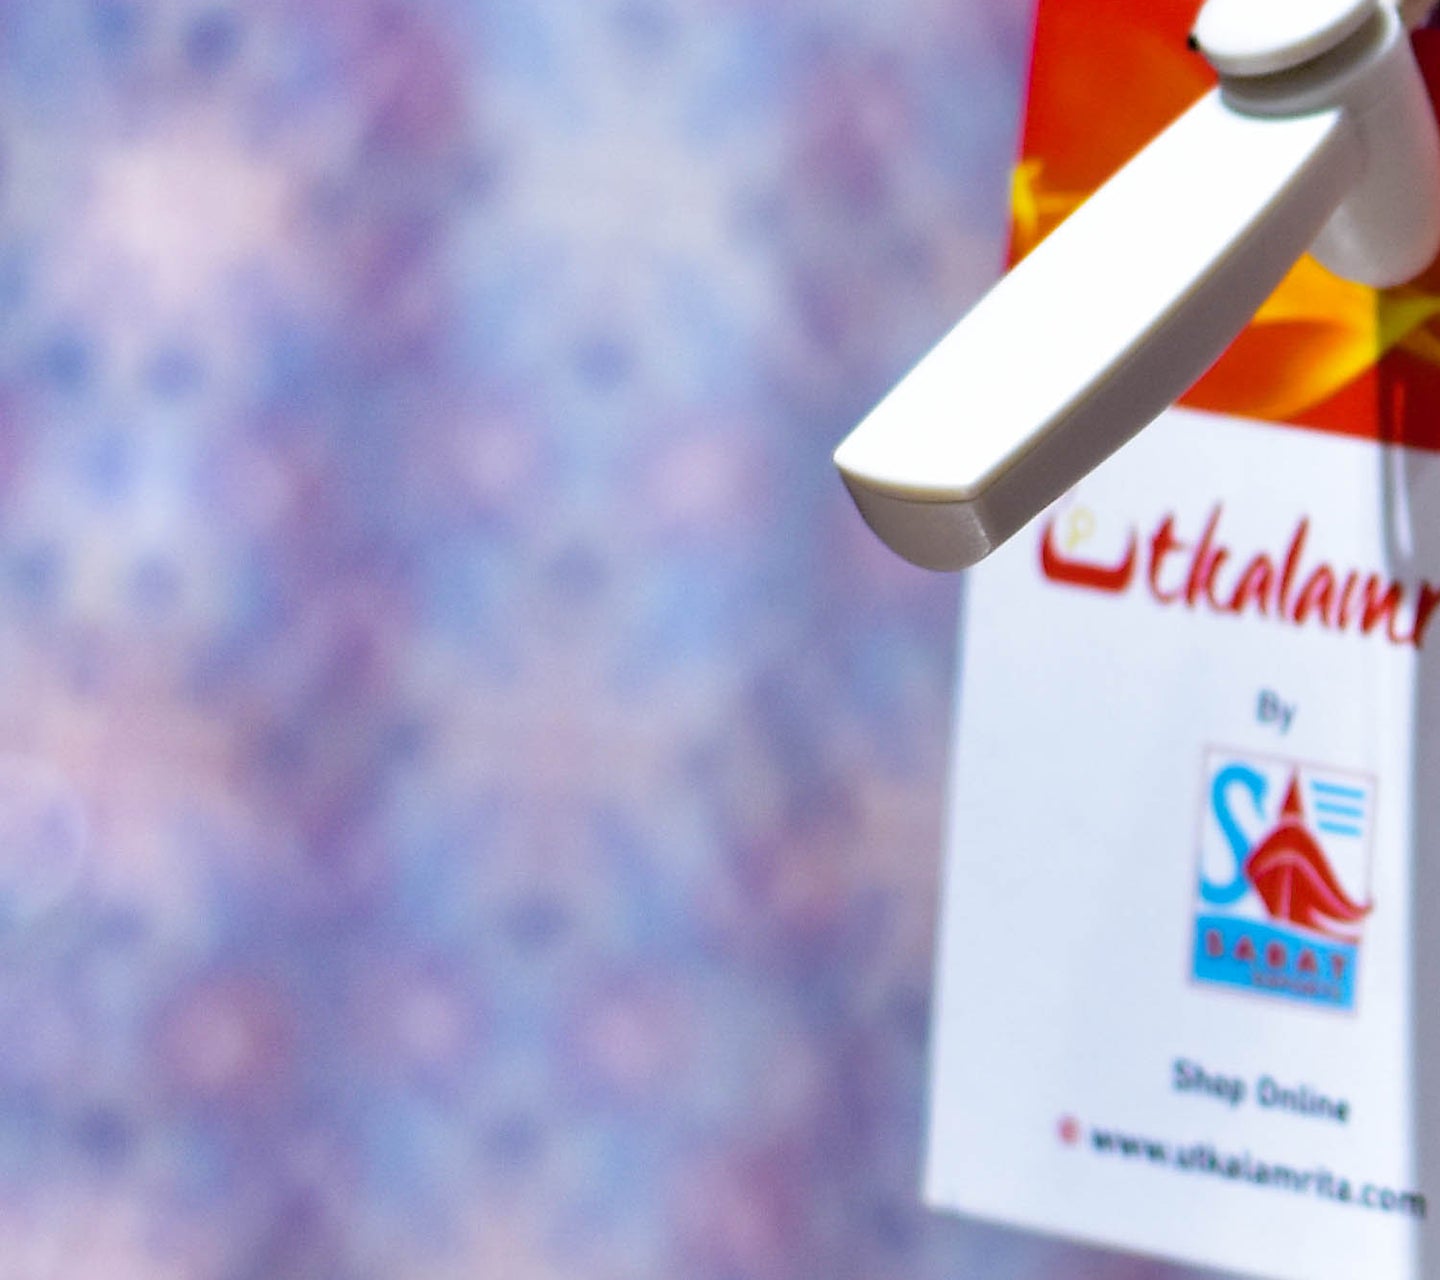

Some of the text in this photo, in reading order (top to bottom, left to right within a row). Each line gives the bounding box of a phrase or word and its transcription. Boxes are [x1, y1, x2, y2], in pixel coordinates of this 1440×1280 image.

[1257, 688, 1295, 735] By
[1172, 1057, 1350, 1125] Shop Online
[1091, 1127, 1428, 1218] www.utkalamrita.com
